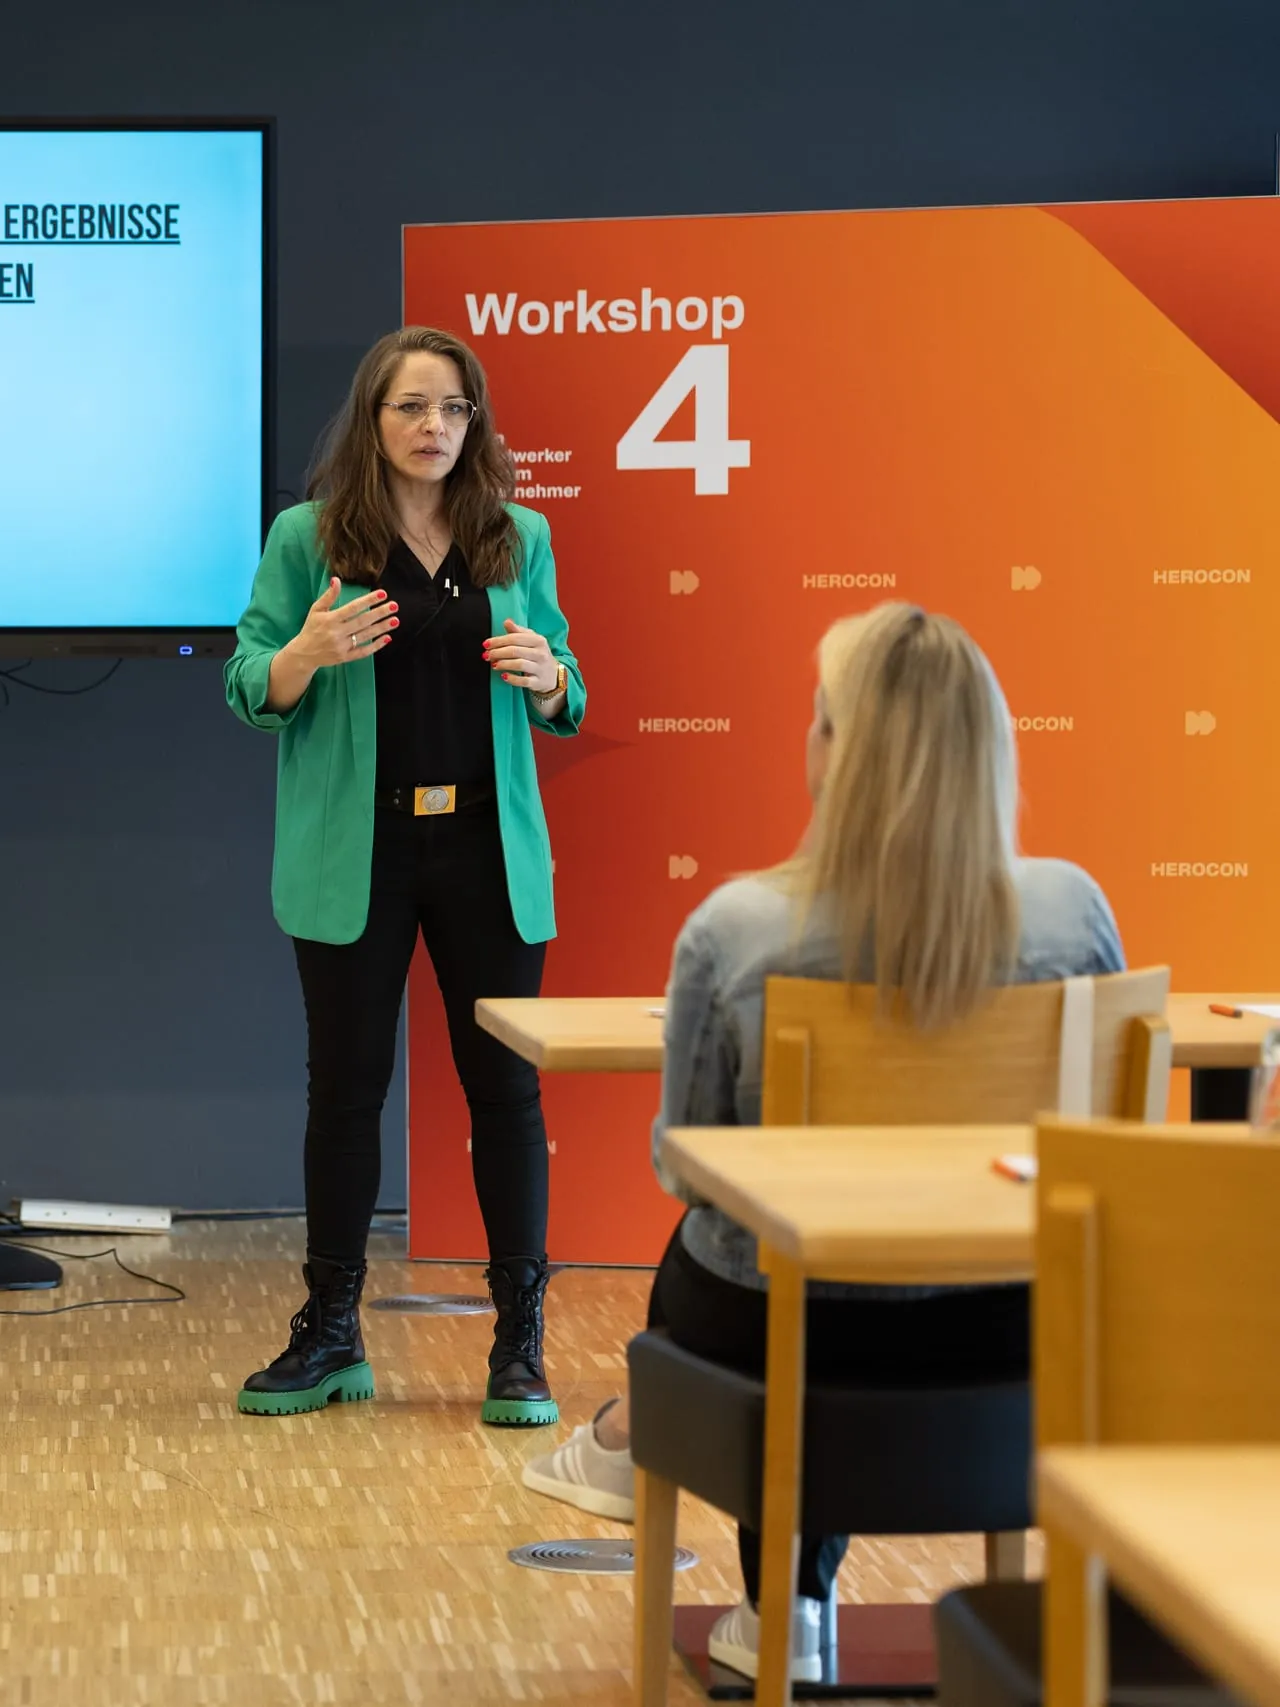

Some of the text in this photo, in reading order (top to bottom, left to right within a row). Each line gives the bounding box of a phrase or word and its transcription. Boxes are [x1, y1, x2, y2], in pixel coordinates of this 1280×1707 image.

[3, 203, 181, 241] ERGEBNISSE
[465, 287, 745, 339] Workshop
[616, 344, 751, 496] 4
[508, 447, 573, 463] werker
[514, 483, 582, 499] nehmer
[802, 573, 897, 589] HEROCON
[1153, 569, 1252, 585] HEROCON
[638, 718, 731, 733] HEROCON
[1012, 716, 1074, 732] OCON
[1150, 862, 1249, 878] HEROCON
